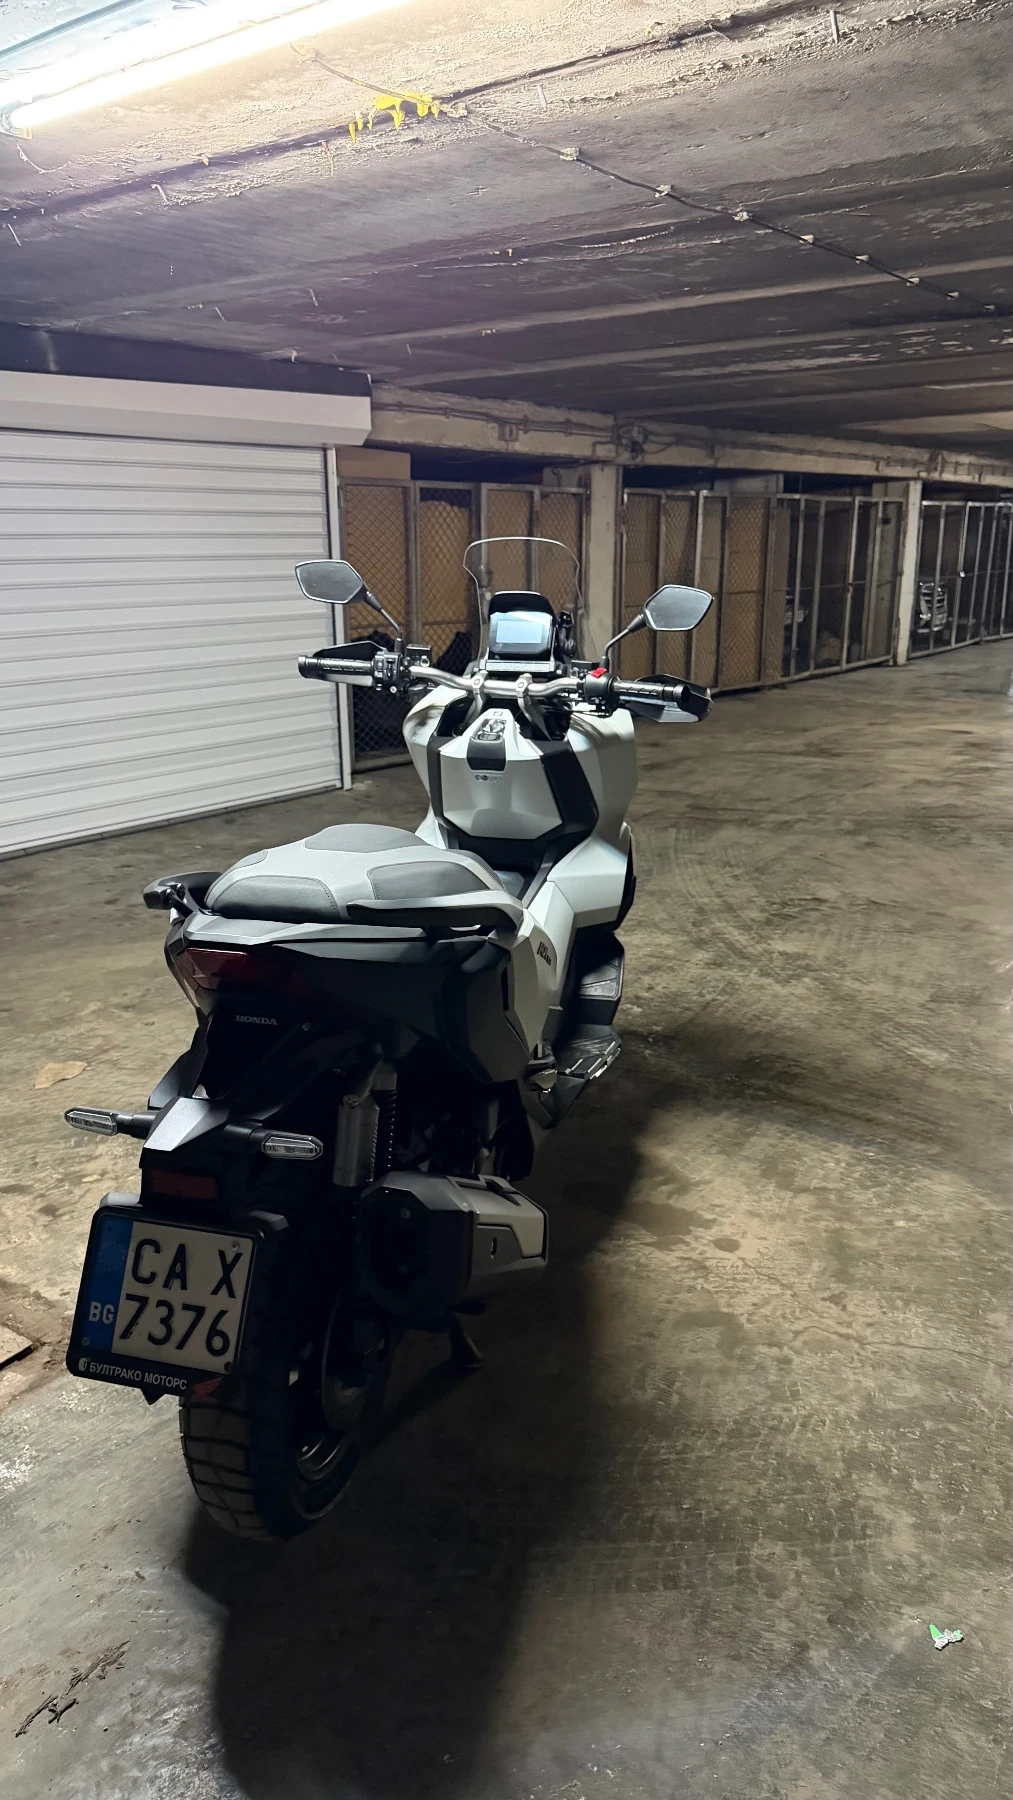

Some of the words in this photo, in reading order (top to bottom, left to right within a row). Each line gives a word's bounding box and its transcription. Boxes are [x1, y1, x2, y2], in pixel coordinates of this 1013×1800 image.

[235, 1014, 278, 1026] HONDA
[131, 1238, 188, 1291] CA
[210, 1249, 243, 1299] X
[88, 1301, 115, 1325] BG
[119, 1293, 230, 1357] 7376
[89, 1362, 142, 1381] БУЛТРАКО
[143, 1372, 188, 1390] МОТОРС
